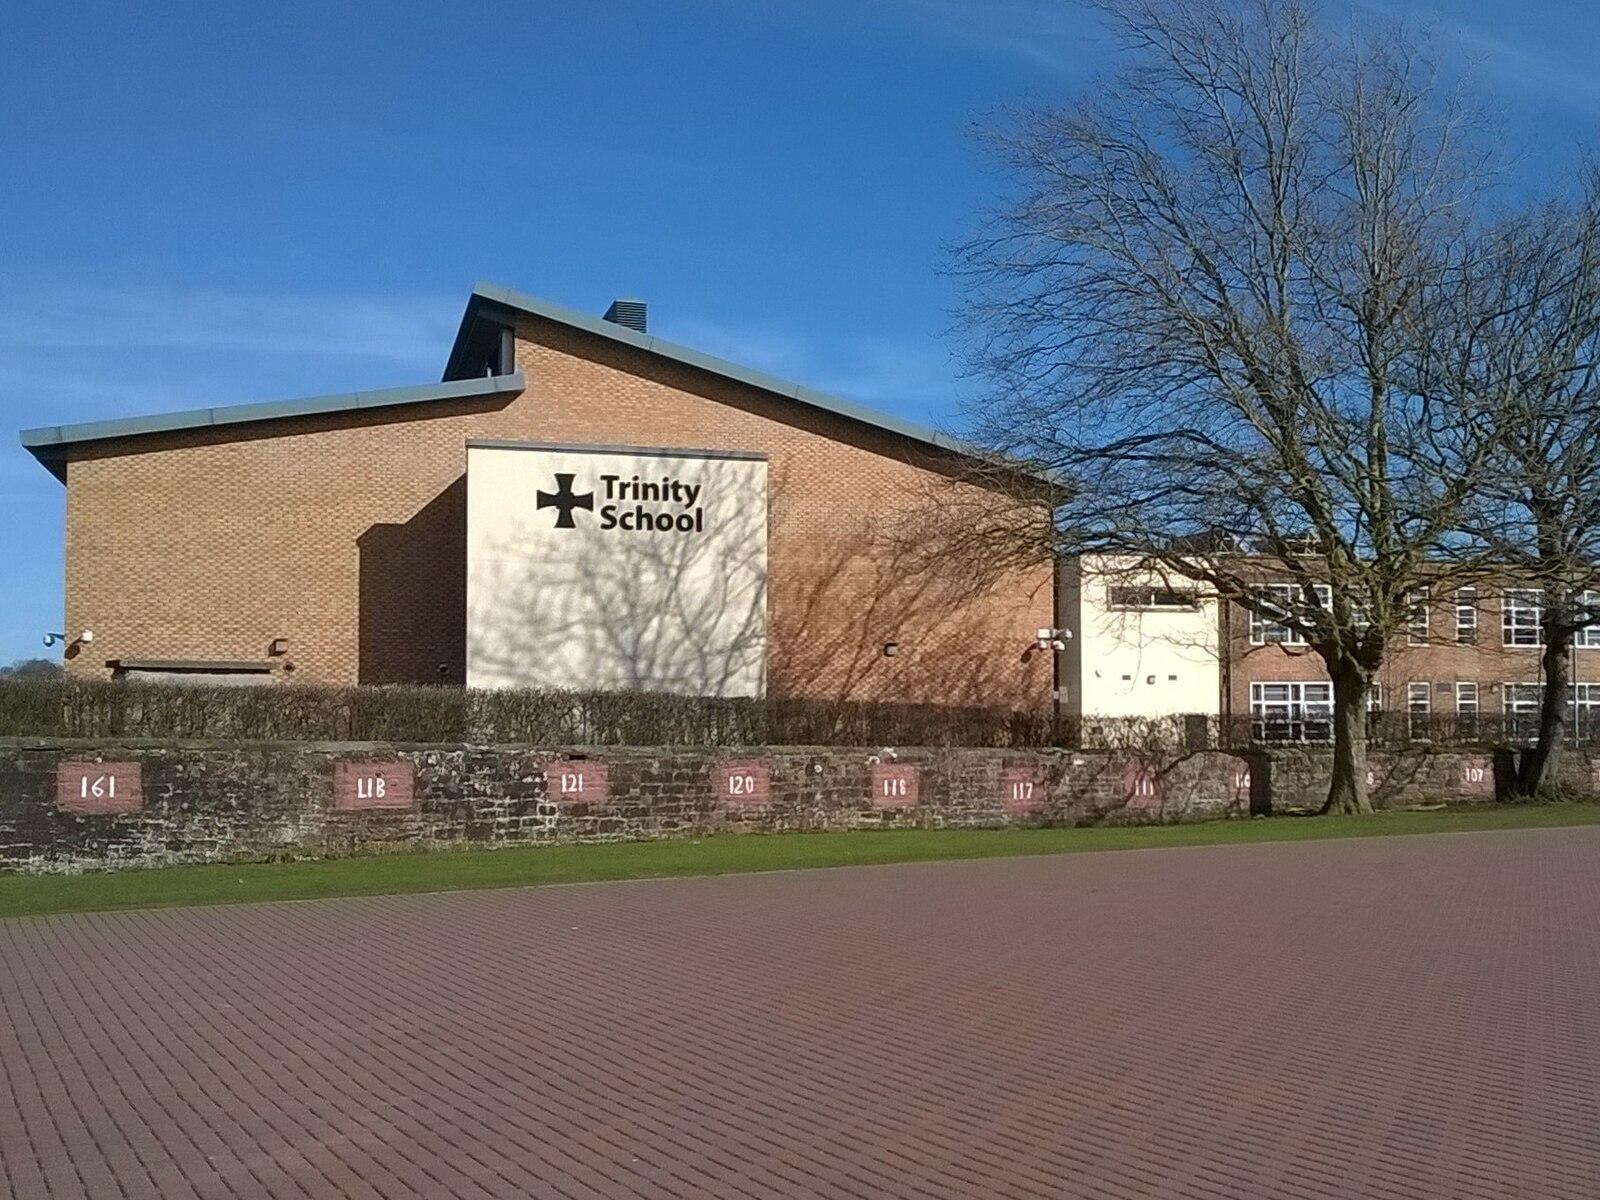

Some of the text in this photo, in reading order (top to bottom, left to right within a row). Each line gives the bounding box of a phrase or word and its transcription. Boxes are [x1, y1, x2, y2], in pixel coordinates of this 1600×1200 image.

[600, 475, 701, 509] Trinity
[600, 505, 702, 532] School
[561, 773, 583, 792] 121
[1465, 767, 1484, 782] 107
[81, 775, 115, 798] 161
[729, 775, 754, 794] 120
[1013, 782, 1033, 799] 117
